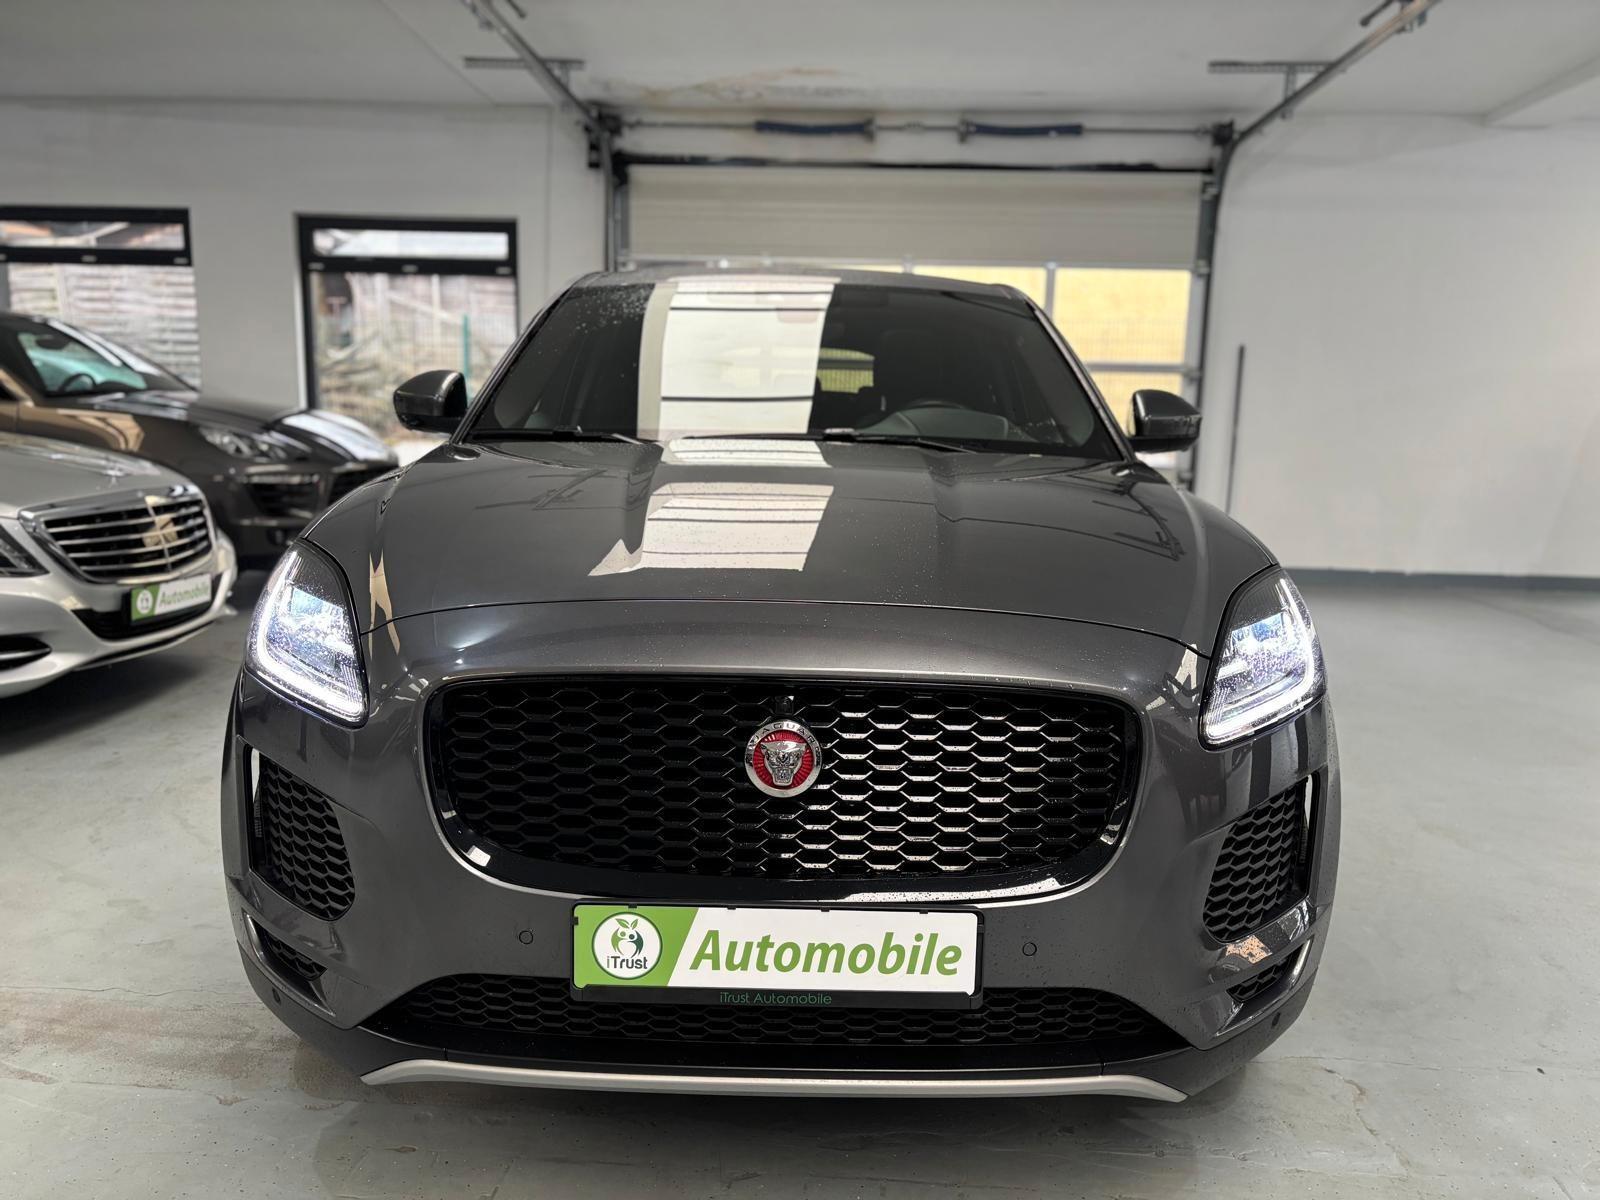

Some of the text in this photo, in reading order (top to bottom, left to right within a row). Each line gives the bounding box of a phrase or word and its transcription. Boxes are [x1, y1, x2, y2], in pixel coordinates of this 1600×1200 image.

[689, 928, 962, 976] Automobile
[606, 954, 648, 970] iTrust
[719, 991, 832, 1006] iTrust Automobile
